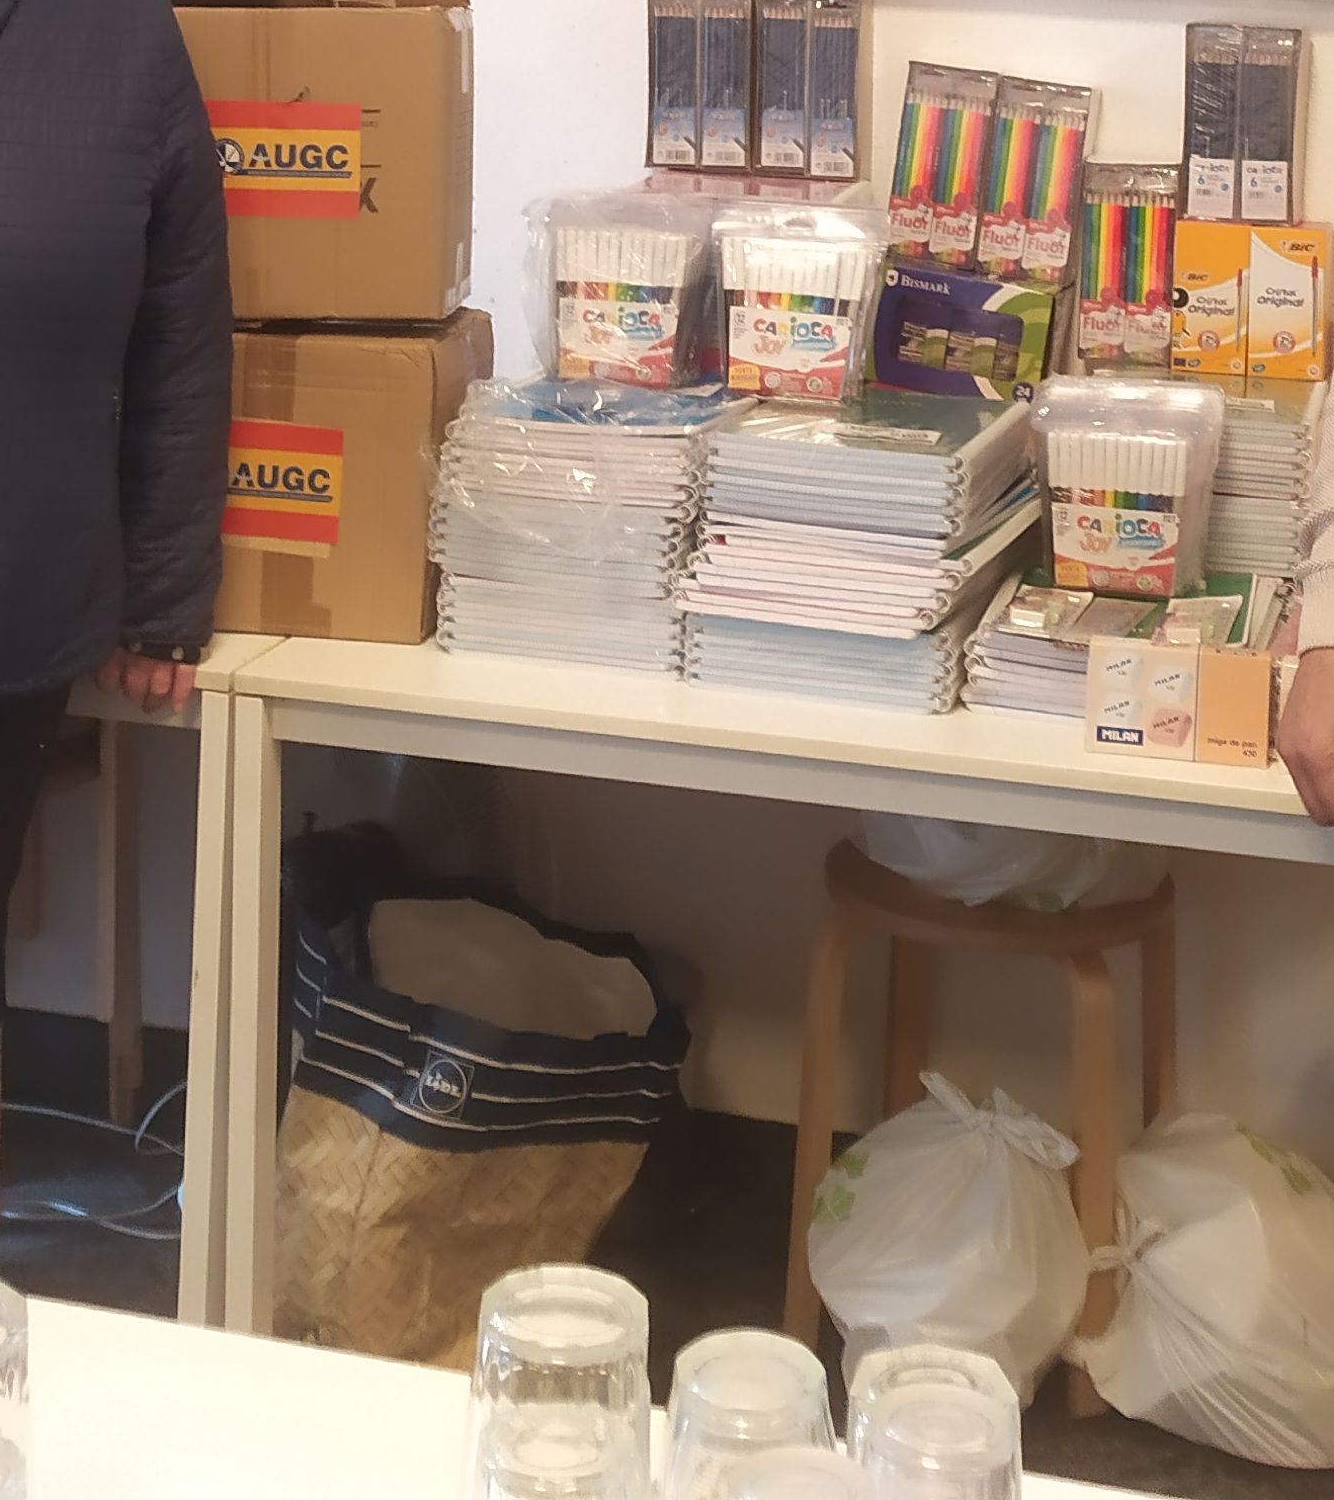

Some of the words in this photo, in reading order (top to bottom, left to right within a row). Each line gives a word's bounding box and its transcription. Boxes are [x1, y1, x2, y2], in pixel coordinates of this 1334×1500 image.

[249, 143, 349, 170] AUGC
[1257, 295, 1305, 308] Original
[1187, 304, 1235, 317] Original
[1016, 385, 1031, 398] 24
[231, 462, 331, 494] AUGC
[1101, 729, 1140, 744] MILAN
